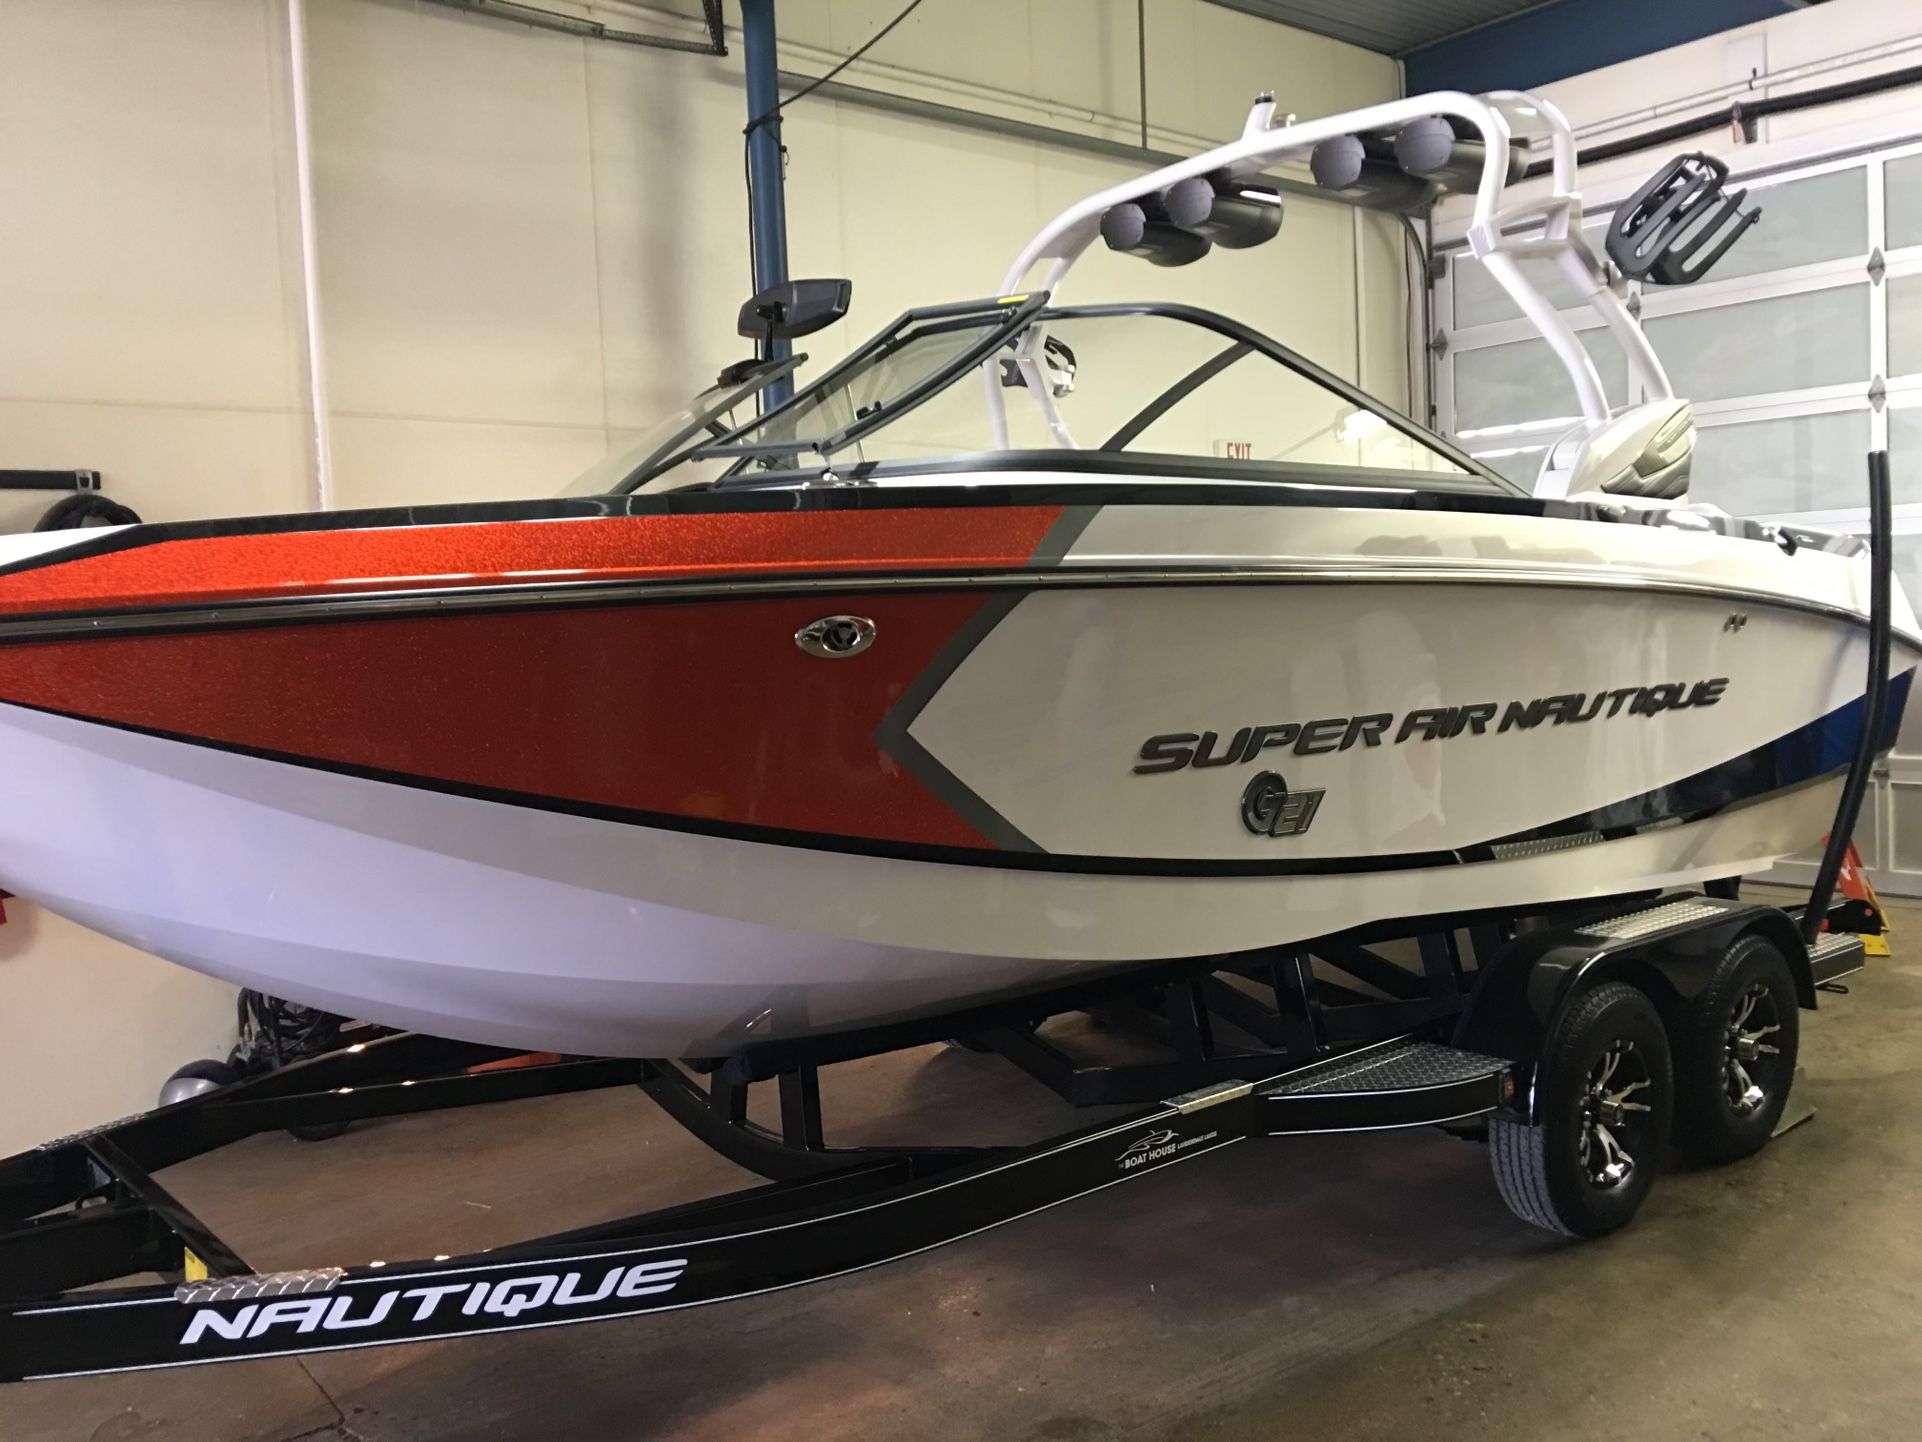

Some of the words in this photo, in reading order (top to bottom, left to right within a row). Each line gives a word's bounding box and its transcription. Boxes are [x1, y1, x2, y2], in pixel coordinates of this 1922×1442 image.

[1133, 712, 1394, 775] SUPER
[1395, 701, 1498, 744] AIR
[1498, 677, 1729, 734] NAUTIQUE
[1125, 1152, 1147, 1169] BOAT
[1148, 1144, 1176, 1160] HOUSE
[180, 1258, 688, 1345] NAUTIQUE
